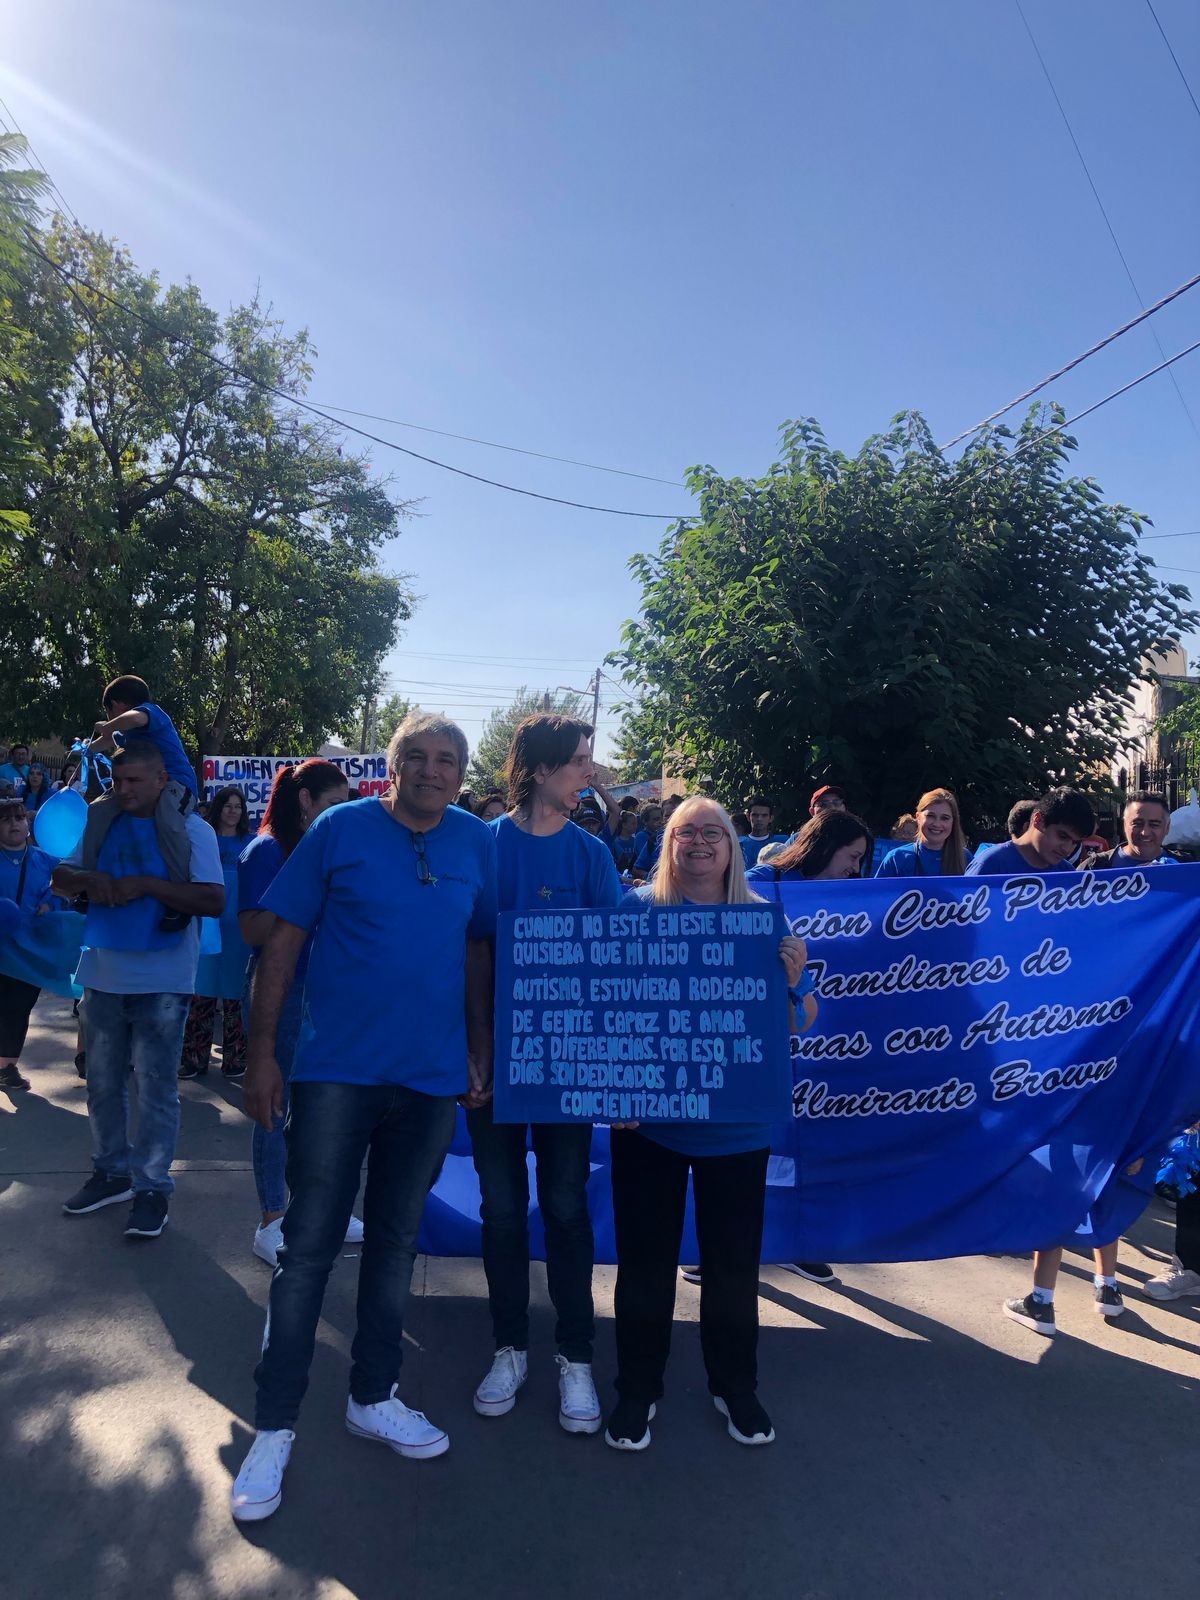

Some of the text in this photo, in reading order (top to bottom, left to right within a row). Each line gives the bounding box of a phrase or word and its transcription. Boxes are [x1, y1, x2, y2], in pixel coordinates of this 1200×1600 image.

[203, 759, 273, 781] ALGUIEN
[882, 884, 991, 940] Civil
[1002, 871, 1150, 922] Padres
[513, 914, 574, 939] CUANDO
[583, 914, 603, 939] NO
[609, 907, 651, 937] ESTÉ
[721, 911, 774, 936] MUNDO
[513, 941, 585, 967] QUISIERA
[590, 941, 622, 967] QUE
[702, 942, 735, 966] CON
[1021, 937, 1072, 977] de
[590, 973, 681, 1002] ESTUVIERA
[689, 977, 767, 1002] RODEADO
[512, 1009, 746, 1034] DE GENTE CAPAZ DE AMAR
[884, 1024, 953, 1056] con
[961, 995, 1133, 1050] Autismo
[511, 1036, 544, 1060] LAS
[660, 1038, 689, 1062] POR
[733, 1035, 763, 1063] MIS
[577, 1061, 665, 1089] DEDICADOS
[676, 1064, 688, 1089] A
[700, 1064, 724, 1089] LA
[792, 1055, 1118, 1119] Almirante Brown
